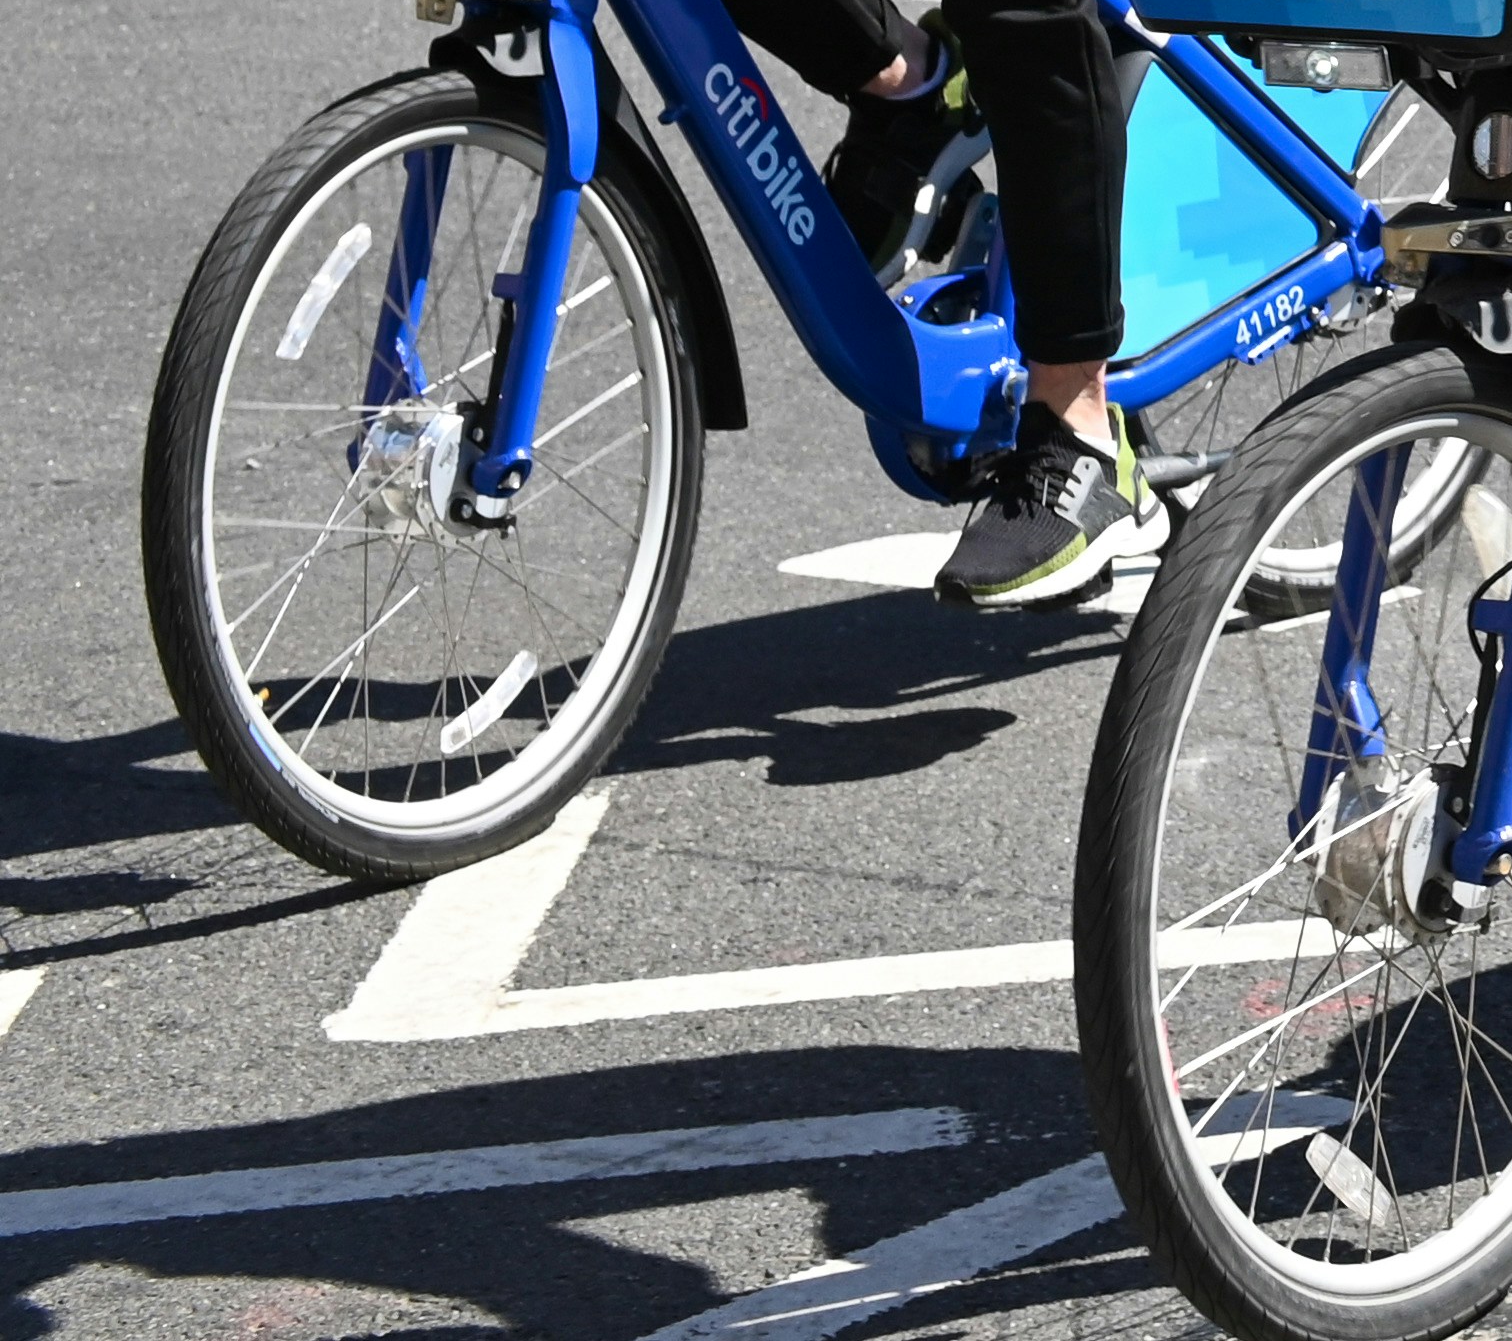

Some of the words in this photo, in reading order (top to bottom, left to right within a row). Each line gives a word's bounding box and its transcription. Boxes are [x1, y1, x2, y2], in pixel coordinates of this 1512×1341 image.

[704, 63, 768, 150] citi
[746, 125, 816, 246] bike
[1236, 285, 1306, 345] 41182
